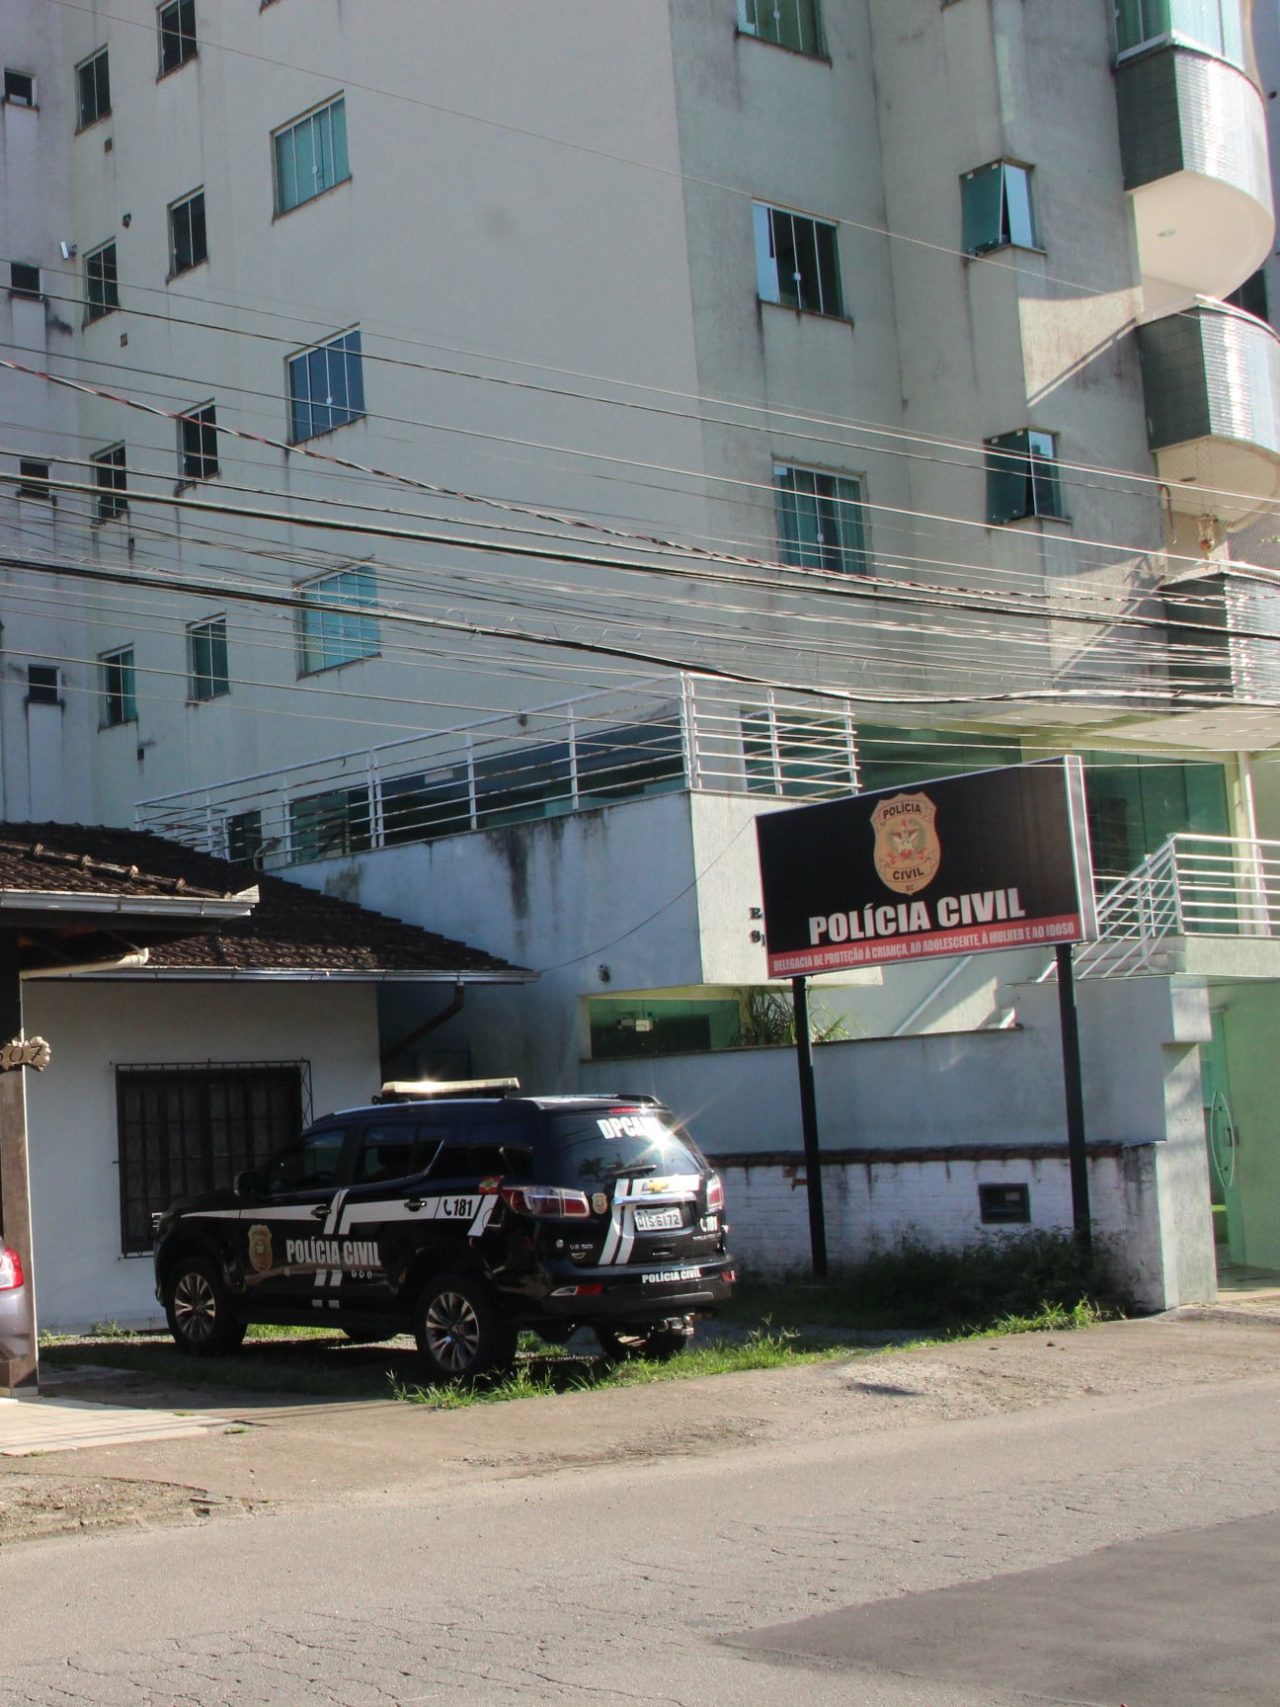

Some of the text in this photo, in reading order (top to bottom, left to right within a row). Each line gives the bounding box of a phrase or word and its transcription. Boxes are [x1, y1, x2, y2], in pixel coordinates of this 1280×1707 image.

[883, 803, 922, 820] POLÍCIA
[892, 867, 925, 880] CIVIL
[808, 901, 932, 946] POLÍCIA
[937, 888, 1026, 927] CIVIL
[774, 957, 813, 971] DELEGACIA
[814, 955, 825, 966] DE
[825, 948, 864, 963] PROTEÇÃO
[910, 941, 921, 954] AO
[989, 928, 1025, 943] MULHER
[1032, 925, 1044, 937] AO
[1046, 922, 1074, 937] IDOSO
[453, 1199, 472, 1217] 181
[286, 1236, 381, 1266] POLÍCIA CIVIL
[642, 1269, 701, 1284] POLÍCIA CIVIL
